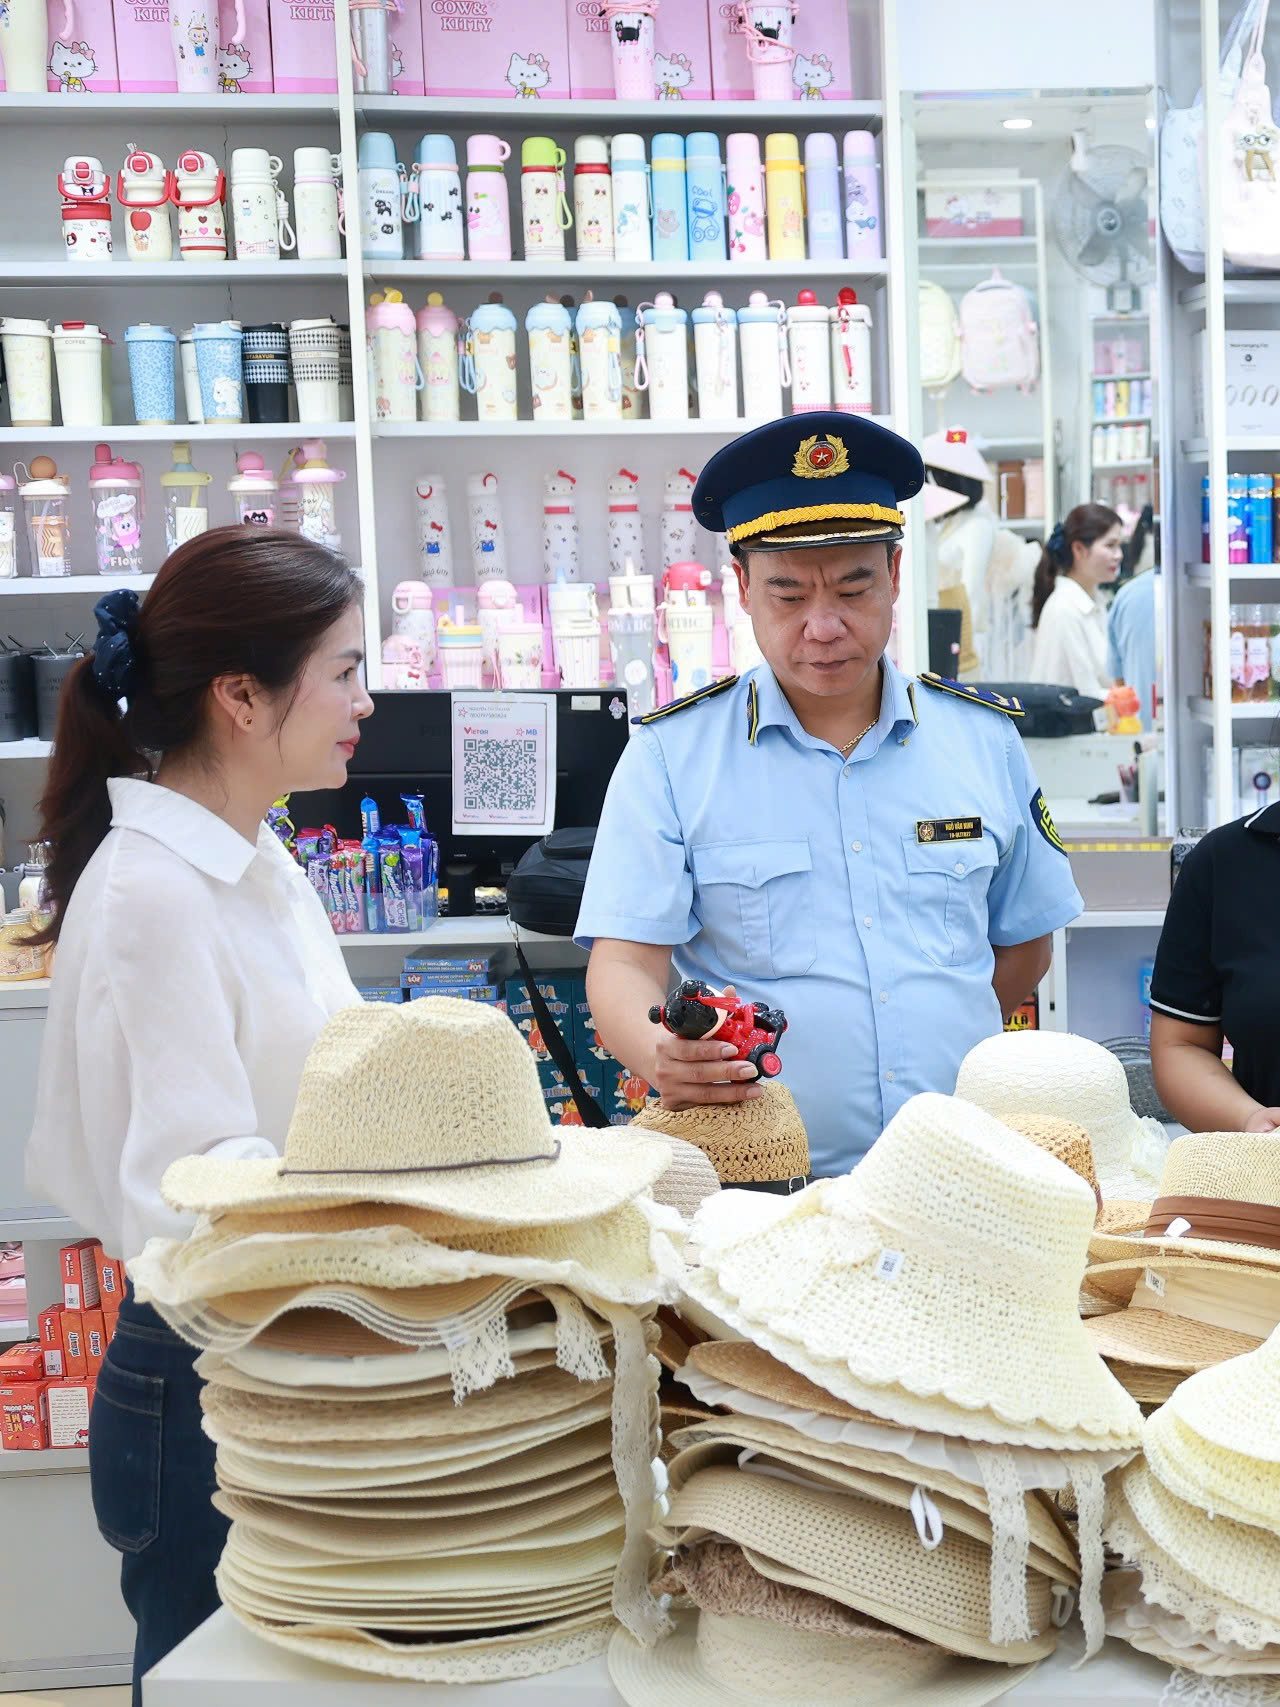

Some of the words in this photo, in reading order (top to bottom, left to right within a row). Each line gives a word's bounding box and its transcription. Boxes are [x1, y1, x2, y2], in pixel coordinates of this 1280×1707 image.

[134, 7, 169, 22] KITT
[431, 1, 487, 16] COW&
[441, 17, 492, 31] KITTY
